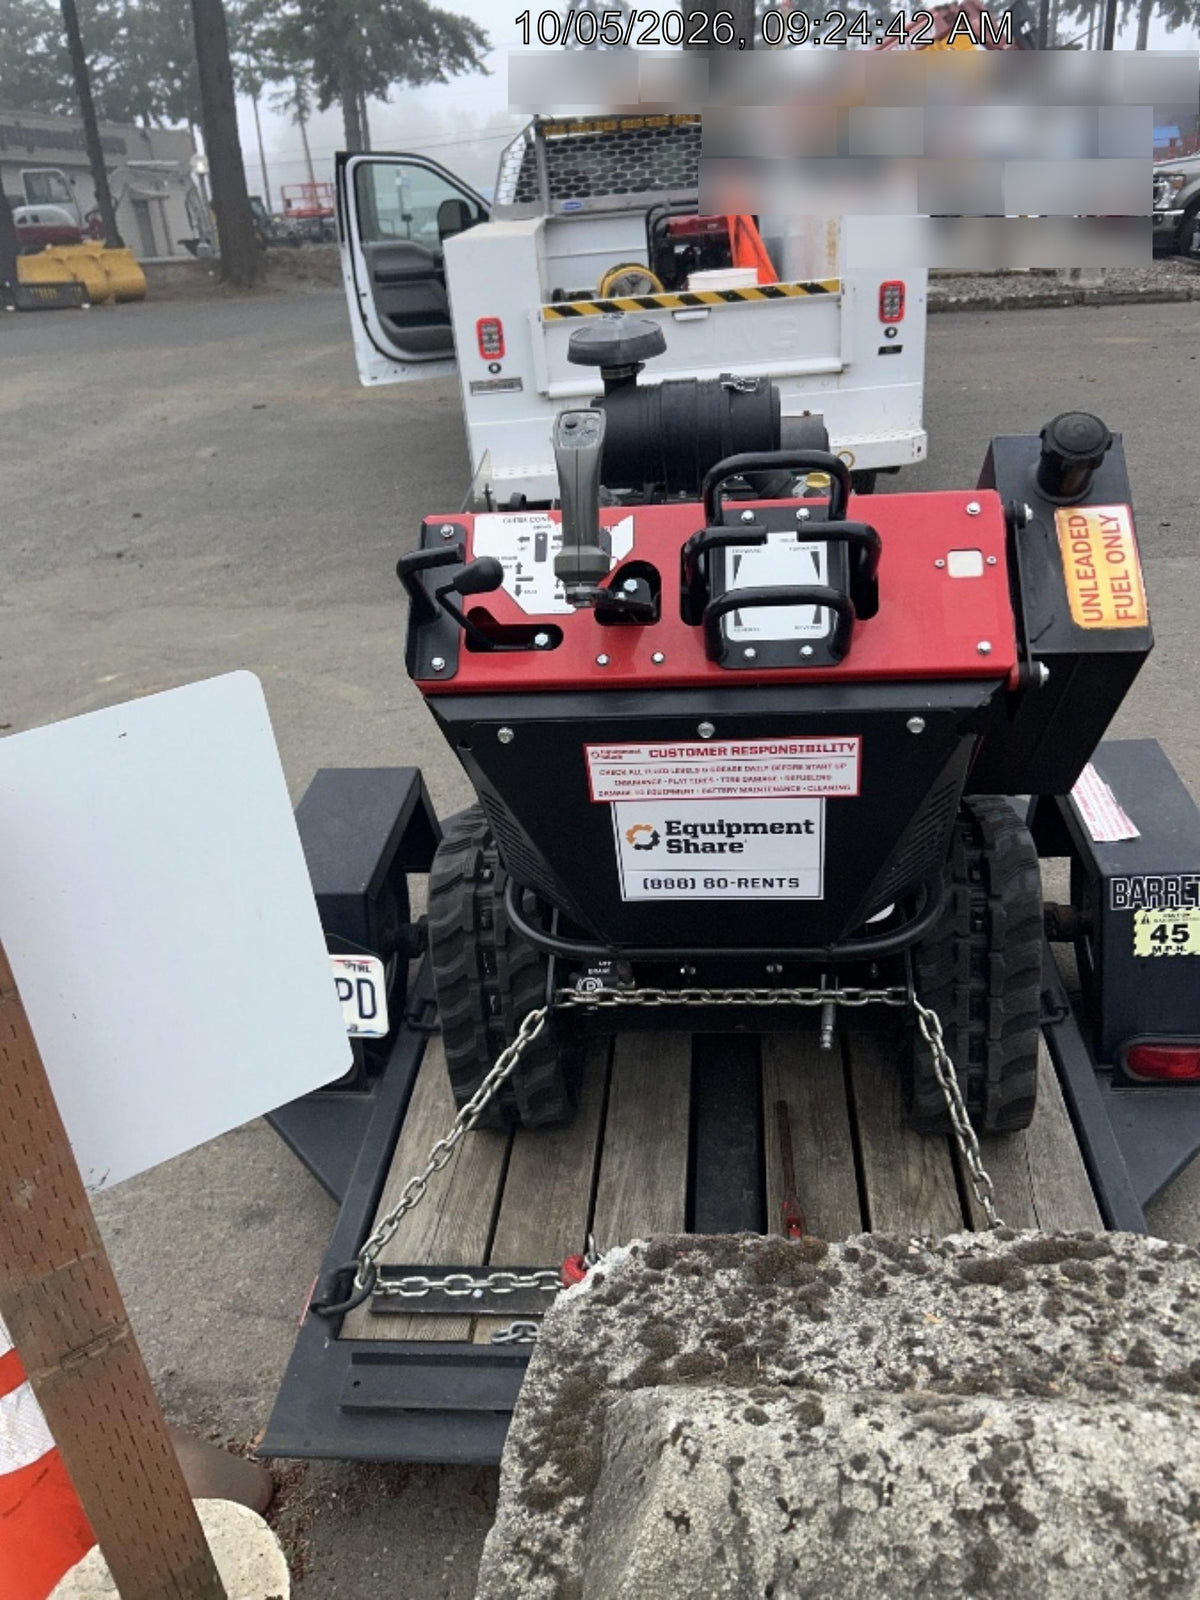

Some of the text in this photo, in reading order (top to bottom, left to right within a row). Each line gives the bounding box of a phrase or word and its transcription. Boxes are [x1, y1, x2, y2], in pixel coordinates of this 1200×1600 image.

[1068, 514, 1103, 623] UNLEADED
[1098, 514, 1137, 620] FUEL ONLY
[648, 743, 856, 758] CUSTOMER RESPONSIBILITY
[664, 819, 815, 838] Equipment
[666, 838, 745, 854] Share
[643, 877, 800, 890] (888) 80-RENTS
[1110, 875, 1200, 910] BARRE
[1149, 924, 1190, 945] 45
